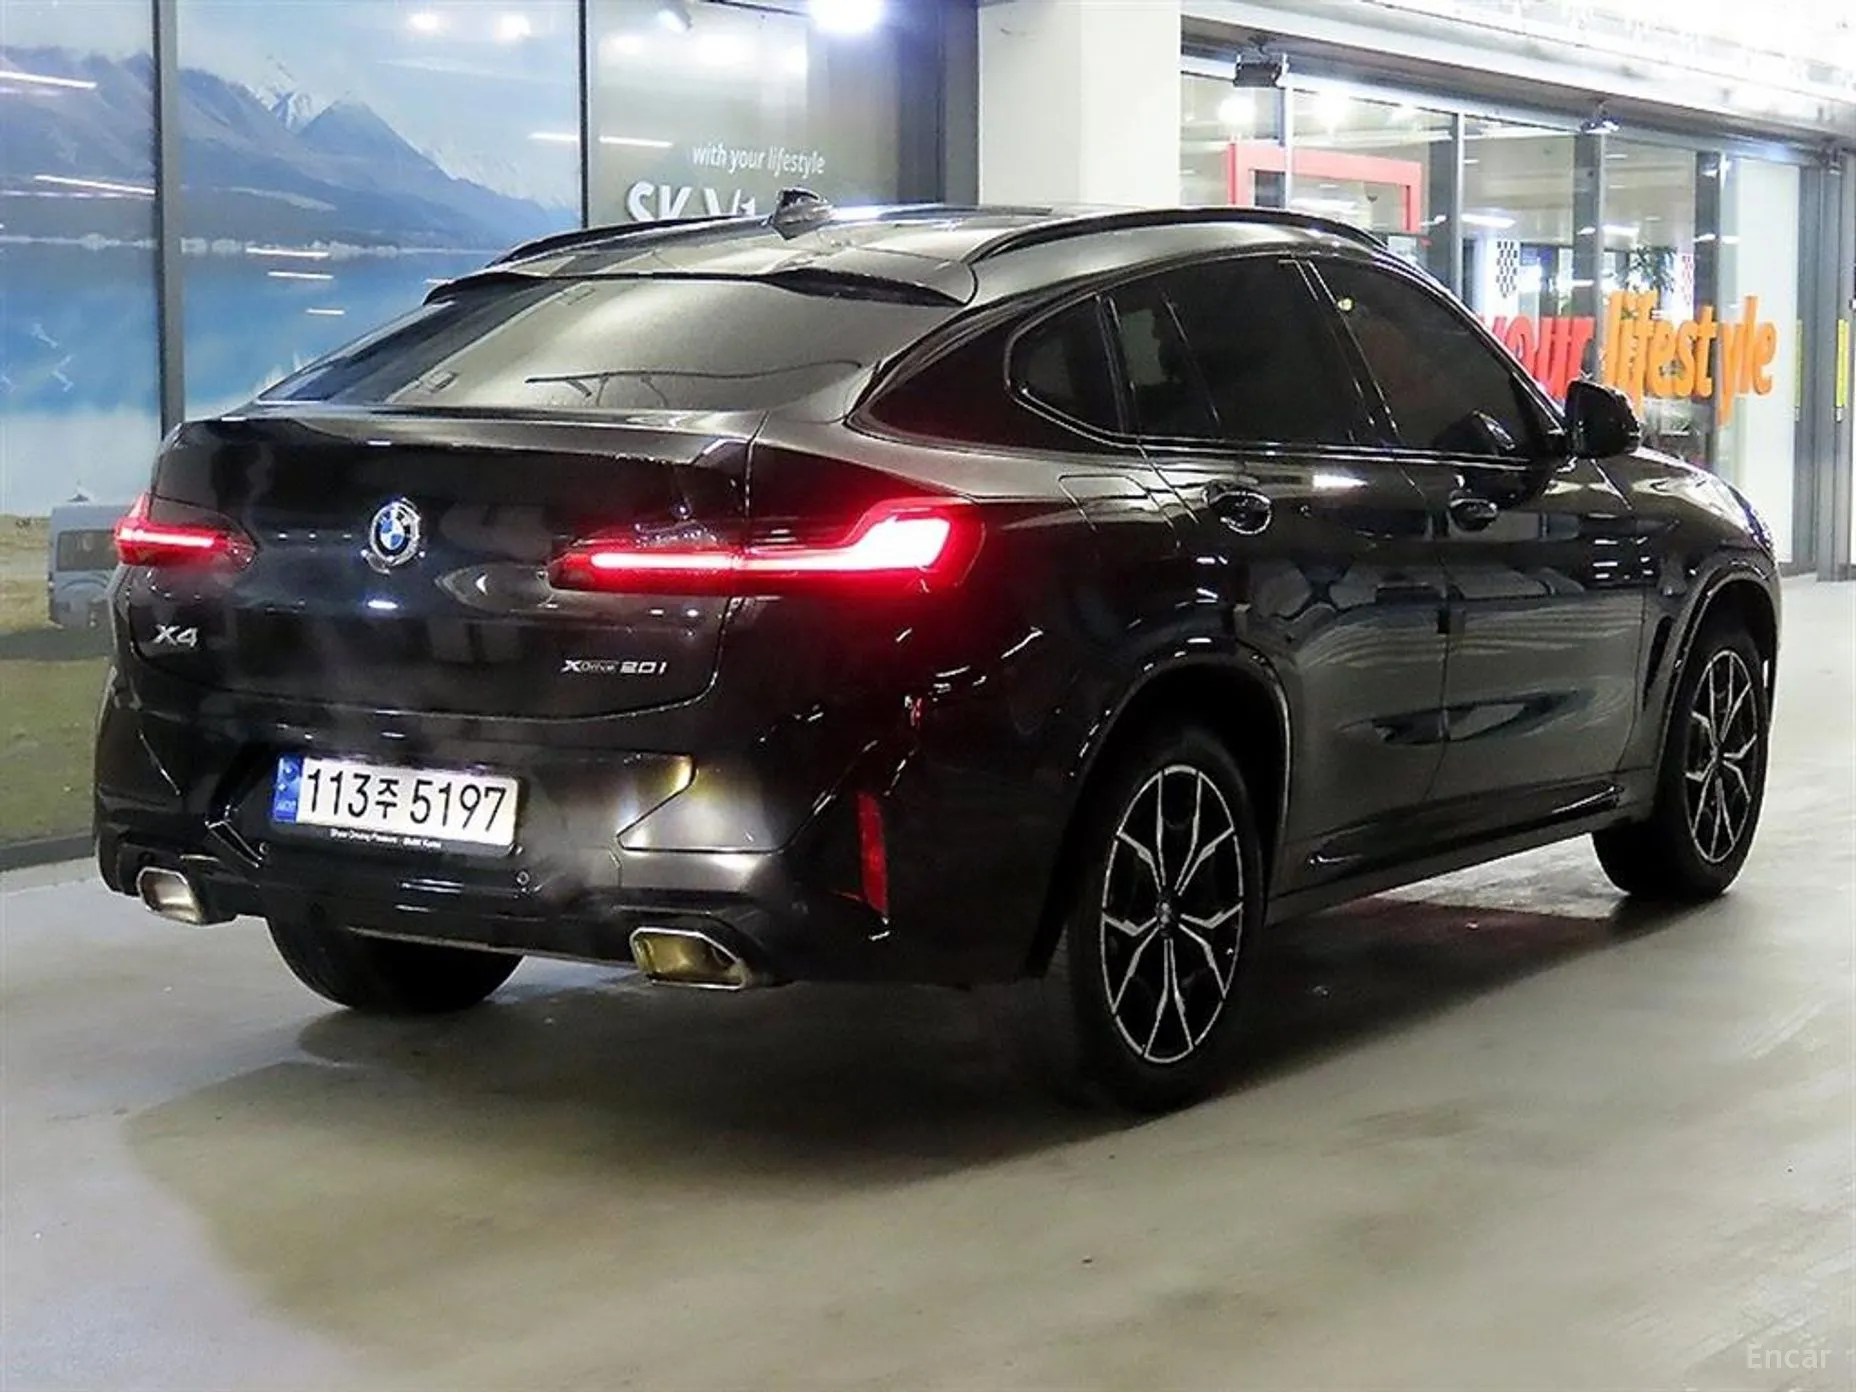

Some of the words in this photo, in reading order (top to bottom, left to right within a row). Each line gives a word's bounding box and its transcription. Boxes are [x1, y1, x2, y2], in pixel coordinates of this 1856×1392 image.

[692, 142, 727, 167] with
[728, 148, 765, 175] your
[766, 143, 826, 179] lifestyle
[1603, 289, 1777, 428] lifestyle
[153, 623, 200, 648] X4
[306, 768, 400, 820] 113주
[409, 779, 507, 832] 5197
